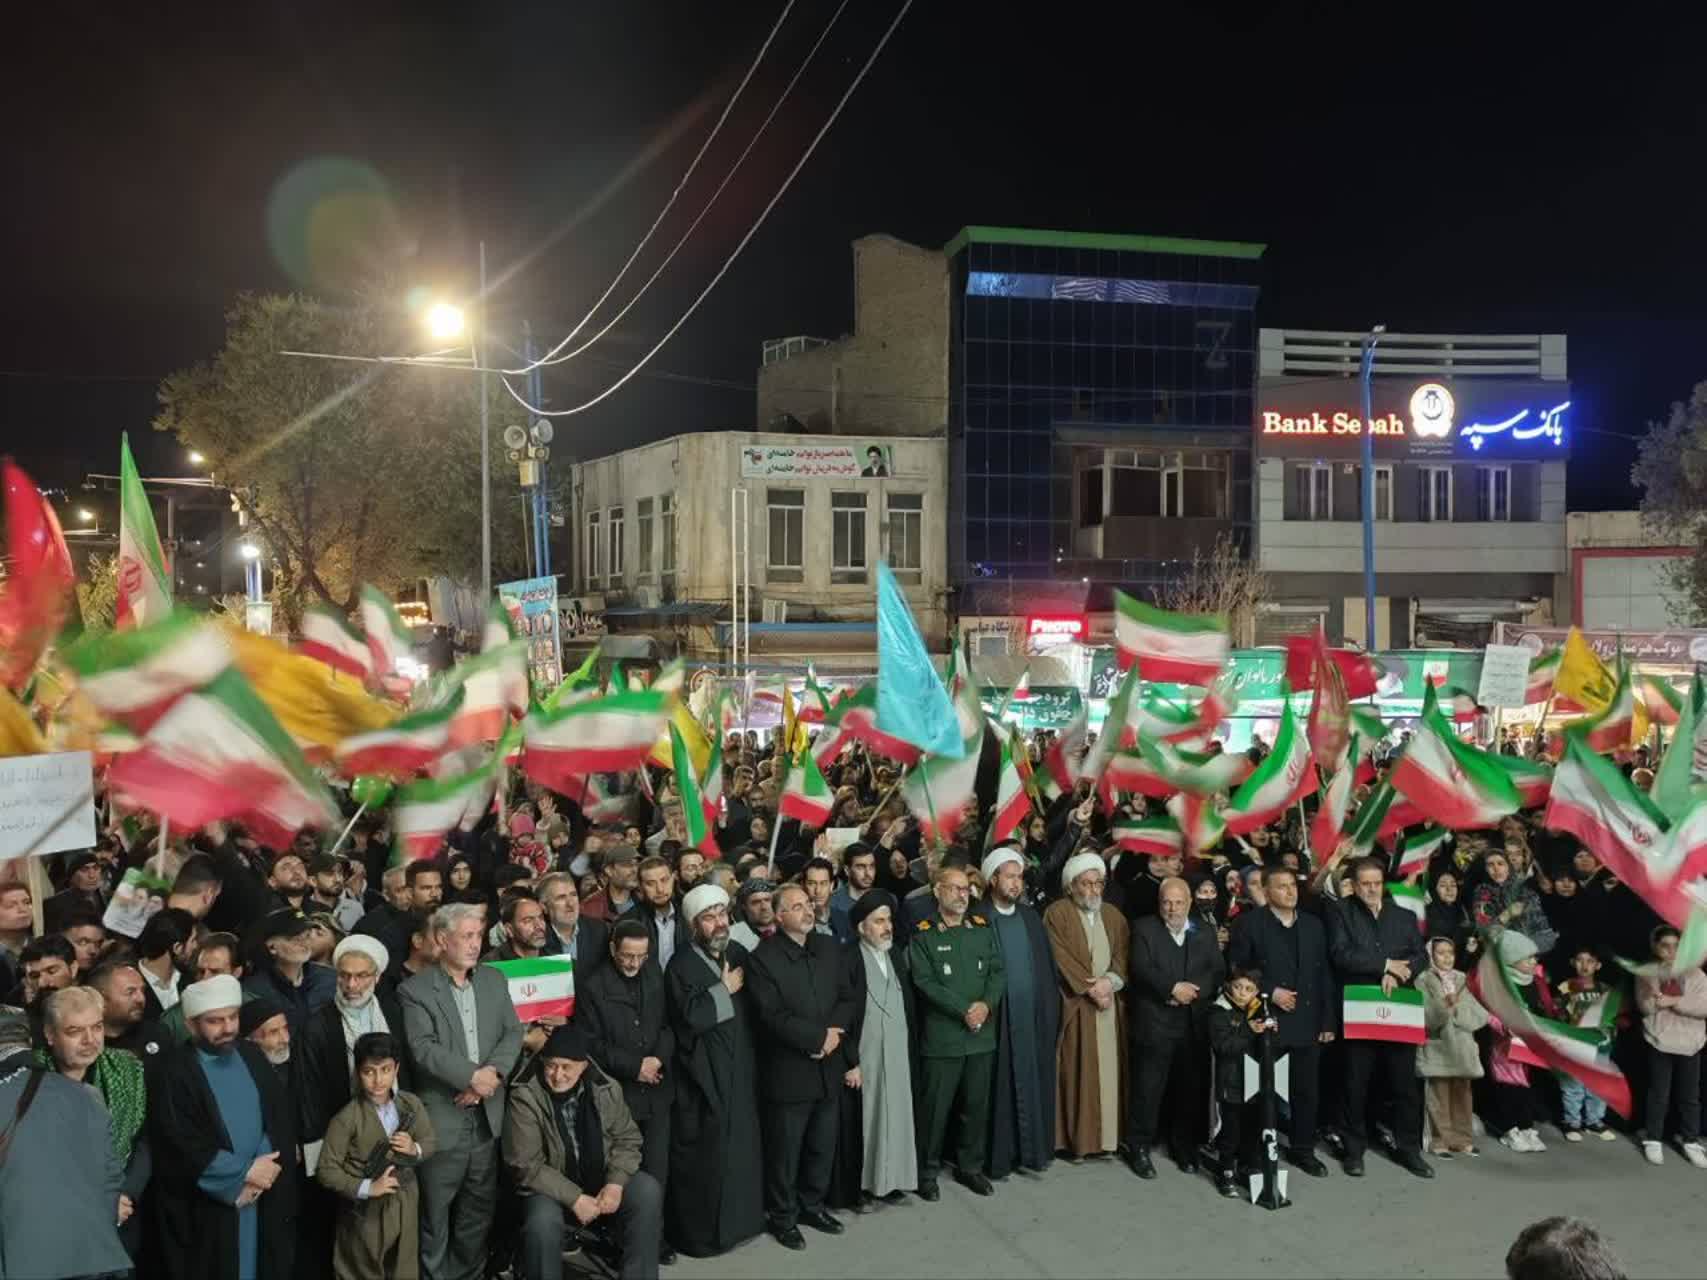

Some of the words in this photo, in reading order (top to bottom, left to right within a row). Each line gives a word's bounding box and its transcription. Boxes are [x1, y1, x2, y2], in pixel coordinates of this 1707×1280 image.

[1262, 411, 1328, 433] Bank
[1460, 408, 1529, 450] سپه
[1512, 401, 1571, 445] بانک
